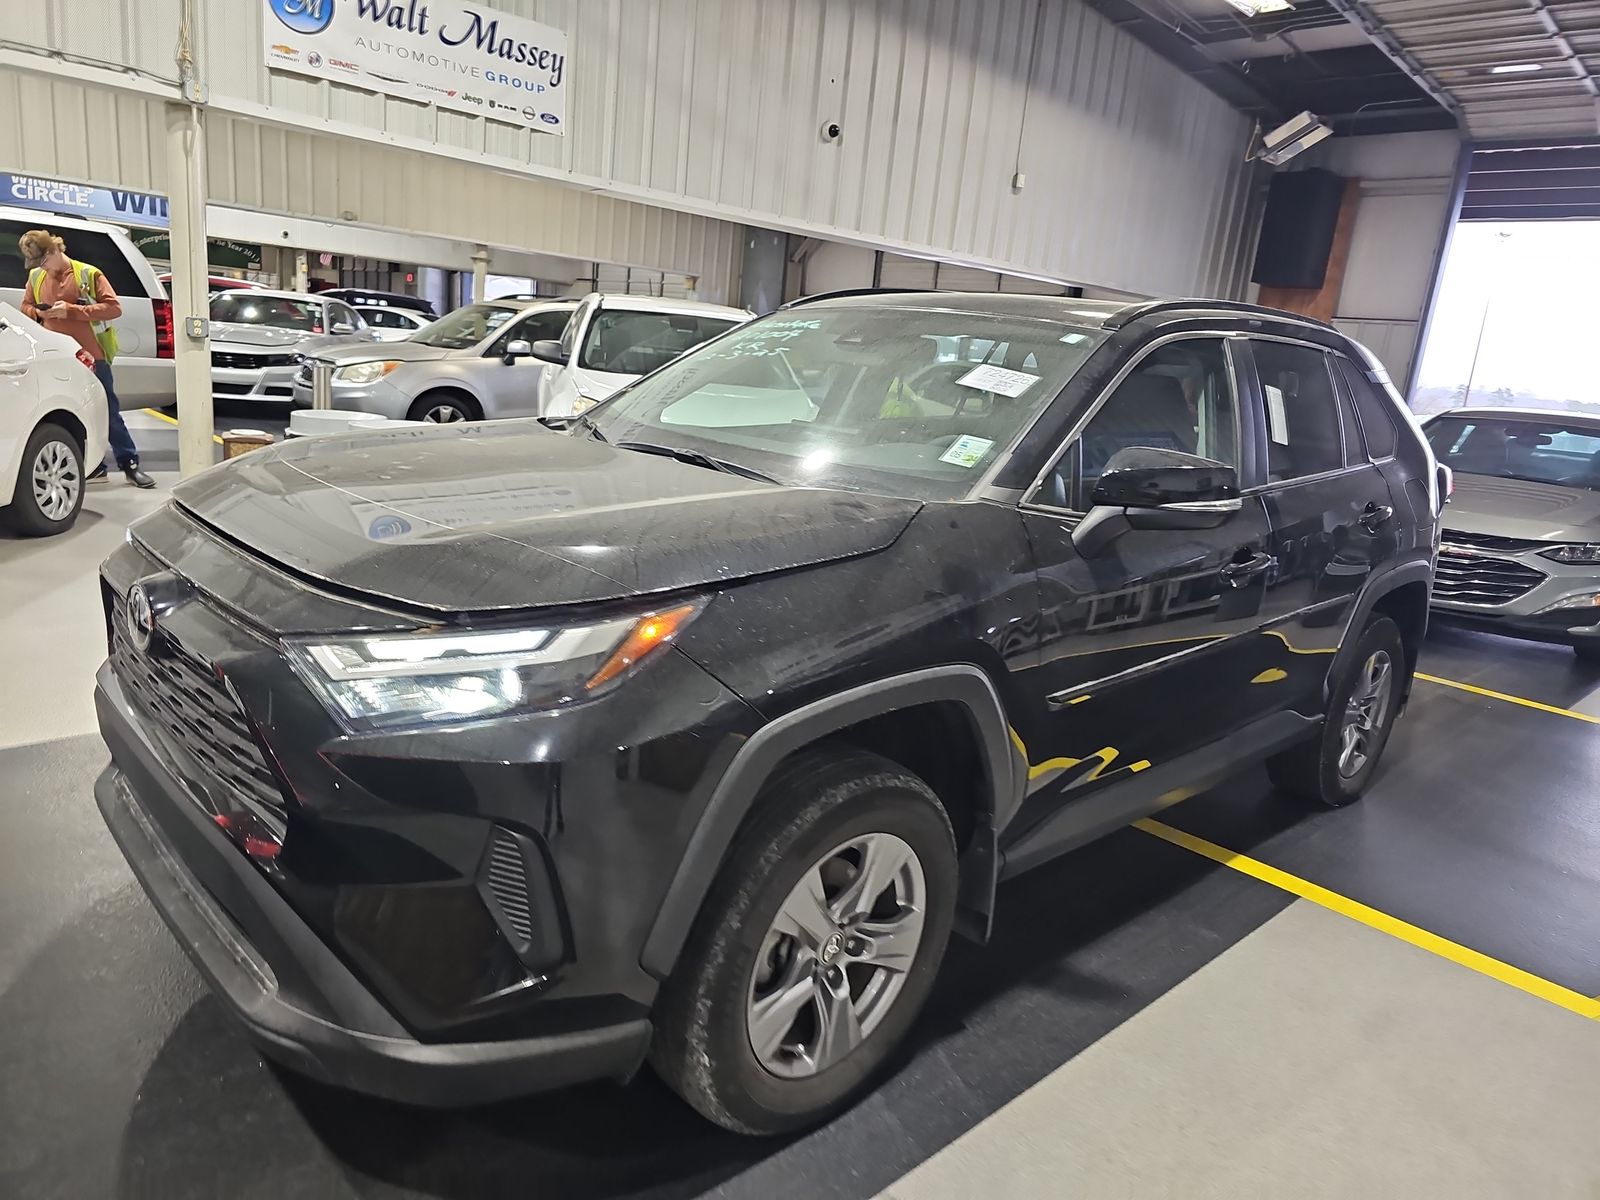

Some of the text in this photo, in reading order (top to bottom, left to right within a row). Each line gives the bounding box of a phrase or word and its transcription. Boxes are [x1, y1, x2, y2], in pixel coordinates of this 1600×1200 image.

[344, 0, 564, 87] Walt Massey
[355, 37, 545, 94] AUTOMOTIVE GROUP
[461, 92, 483, 105] Jeep
[541, 114, 558, 124] Ford
[11, 176, 94, 193] WINNERS
[11, 183, 95, 208] CIRCLE.
